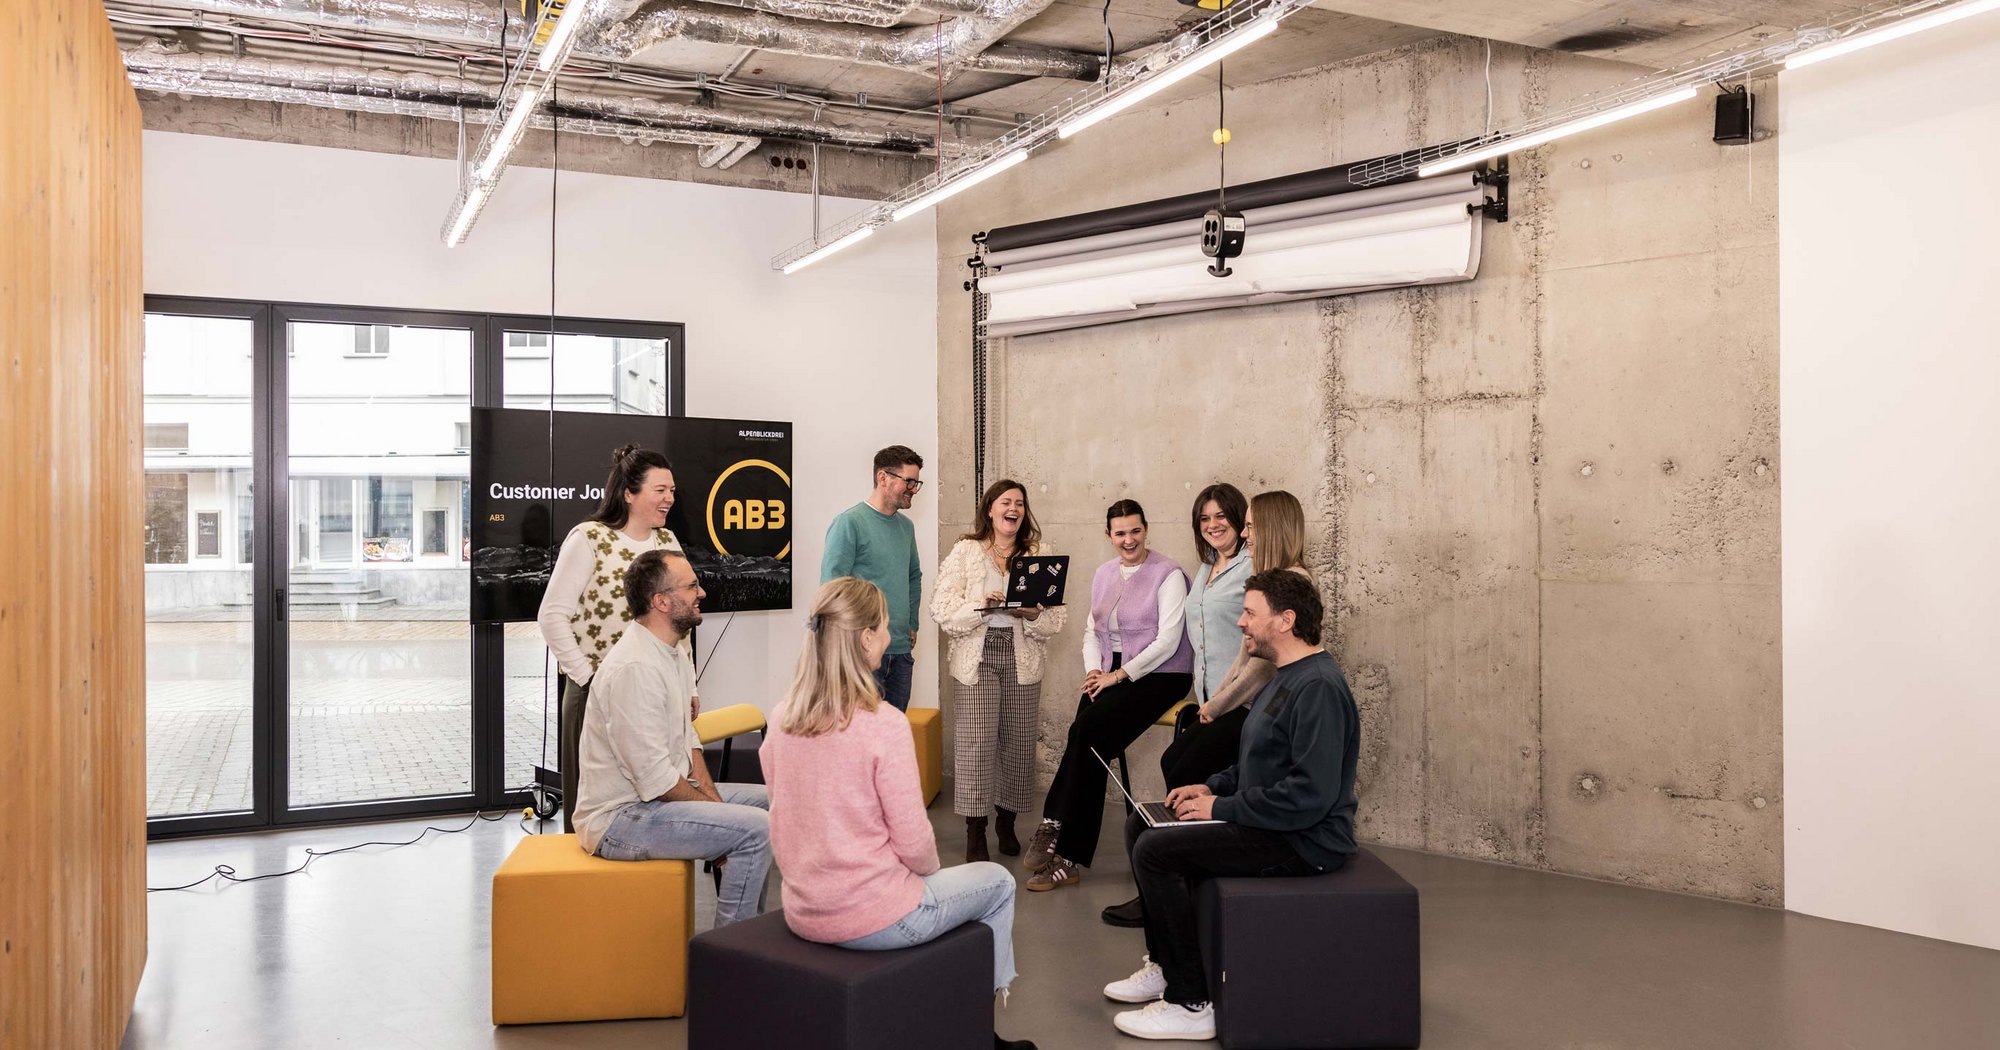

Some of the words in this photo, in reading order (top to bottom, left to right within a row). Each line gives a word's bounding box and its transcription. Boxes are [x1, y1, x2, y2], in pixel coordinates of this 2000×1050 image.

[489, 482, 576, 500] Customer
[489, 514, 505, 522] AB3
[724, 499, 786, 530] AB3
